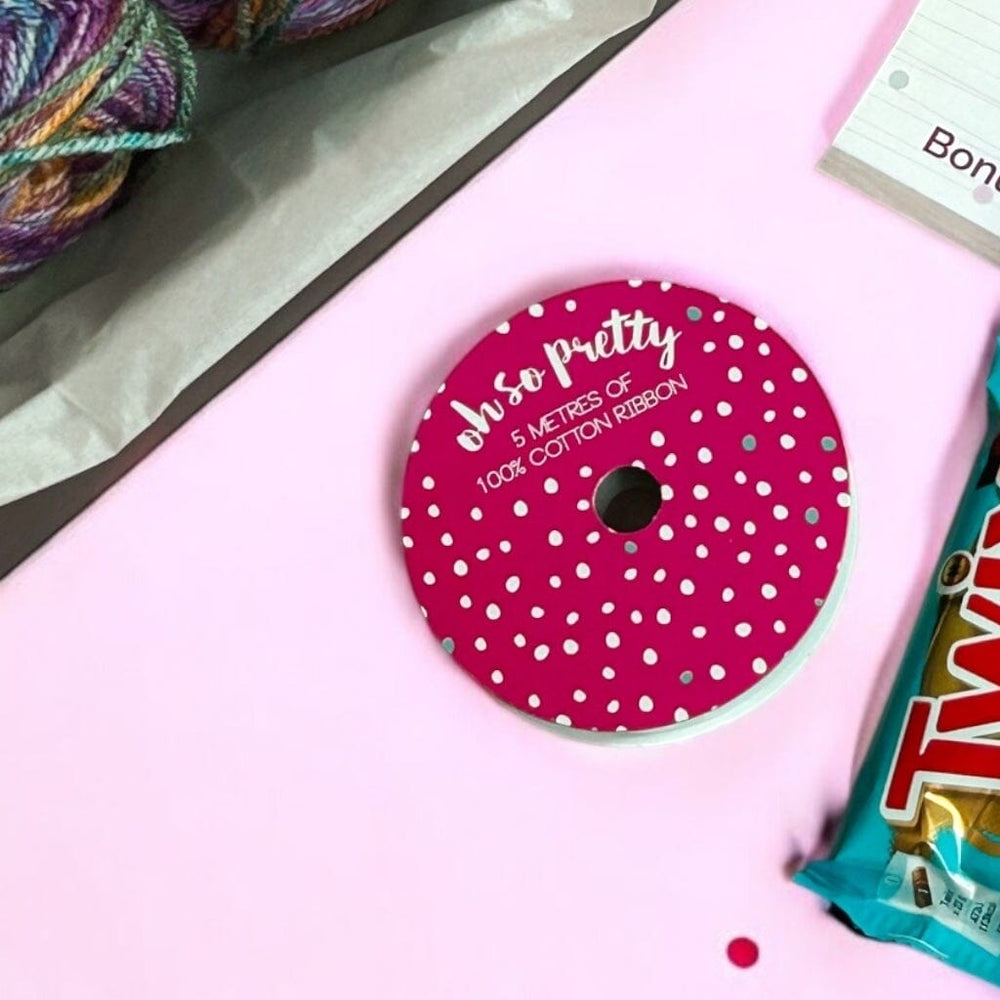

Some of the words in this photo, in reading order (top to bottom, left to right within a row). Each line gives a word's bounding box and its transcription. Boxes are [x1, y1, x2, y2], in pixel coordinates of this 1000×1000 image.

[449, 397, 505, 452] oh
[493, 366, 546, 406] so
[543, 308, 683, 389] pretty
[475, 455, 527, 494] 100%
[528, 412, 613, 467] COTTON
[611, 373, 690, 425] RIBBON
[510, 430, 527, 448] 5
[526, 389, 604, 438] METRES
[604, 371, 634, 400] OF
